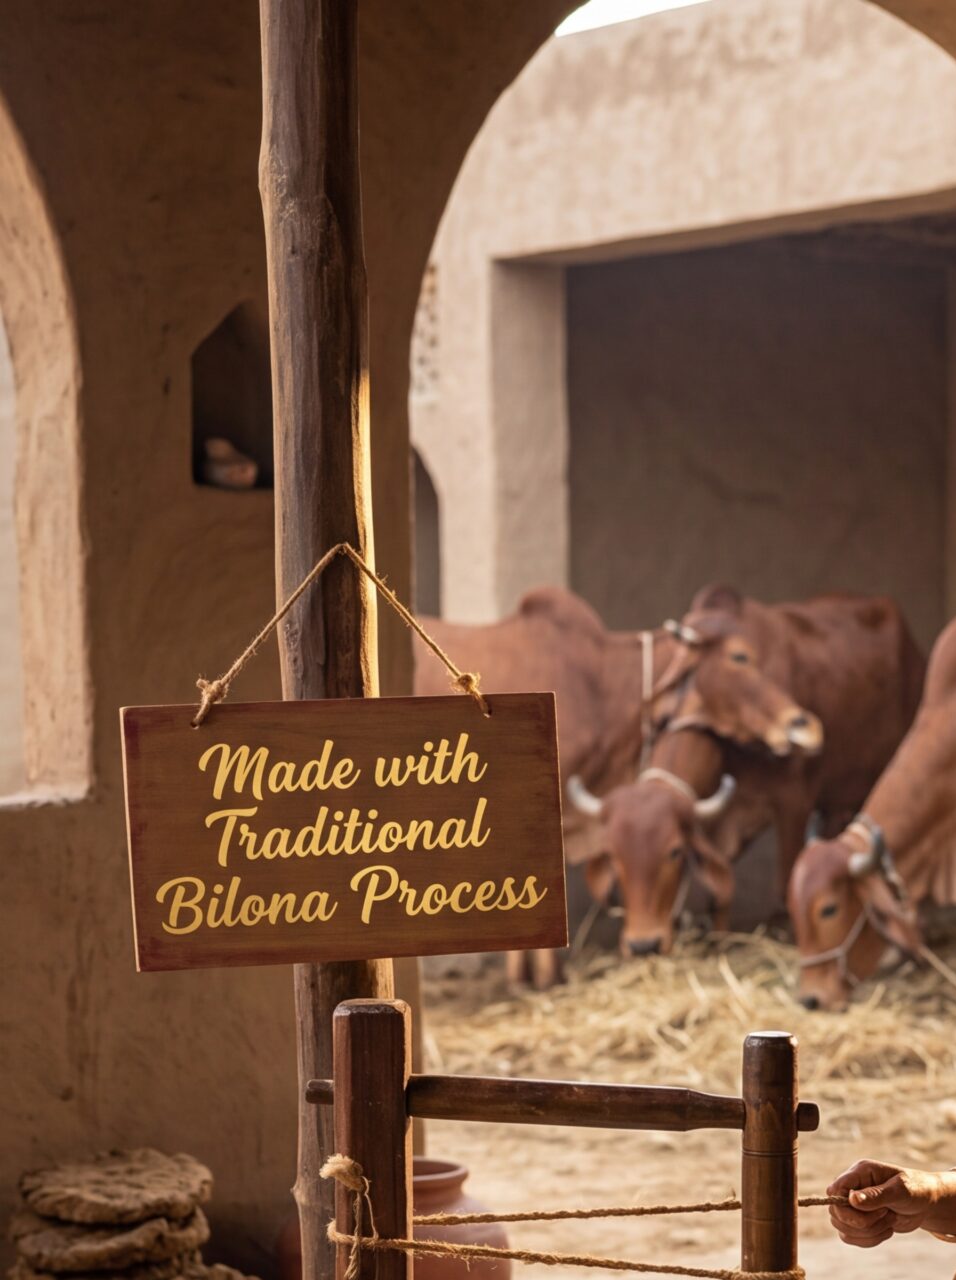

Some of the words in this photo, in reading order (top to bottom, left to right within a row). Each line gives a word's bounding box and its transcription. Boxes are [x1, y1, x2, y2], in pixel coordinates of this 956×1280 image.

[198, 739, 361, 801] Made
[374, 732, 488, 788] with
[205, 797, 490, 867] Traditional
[155, 876, 338, 935] Bilona
[350, 865, 548, 924] Process
